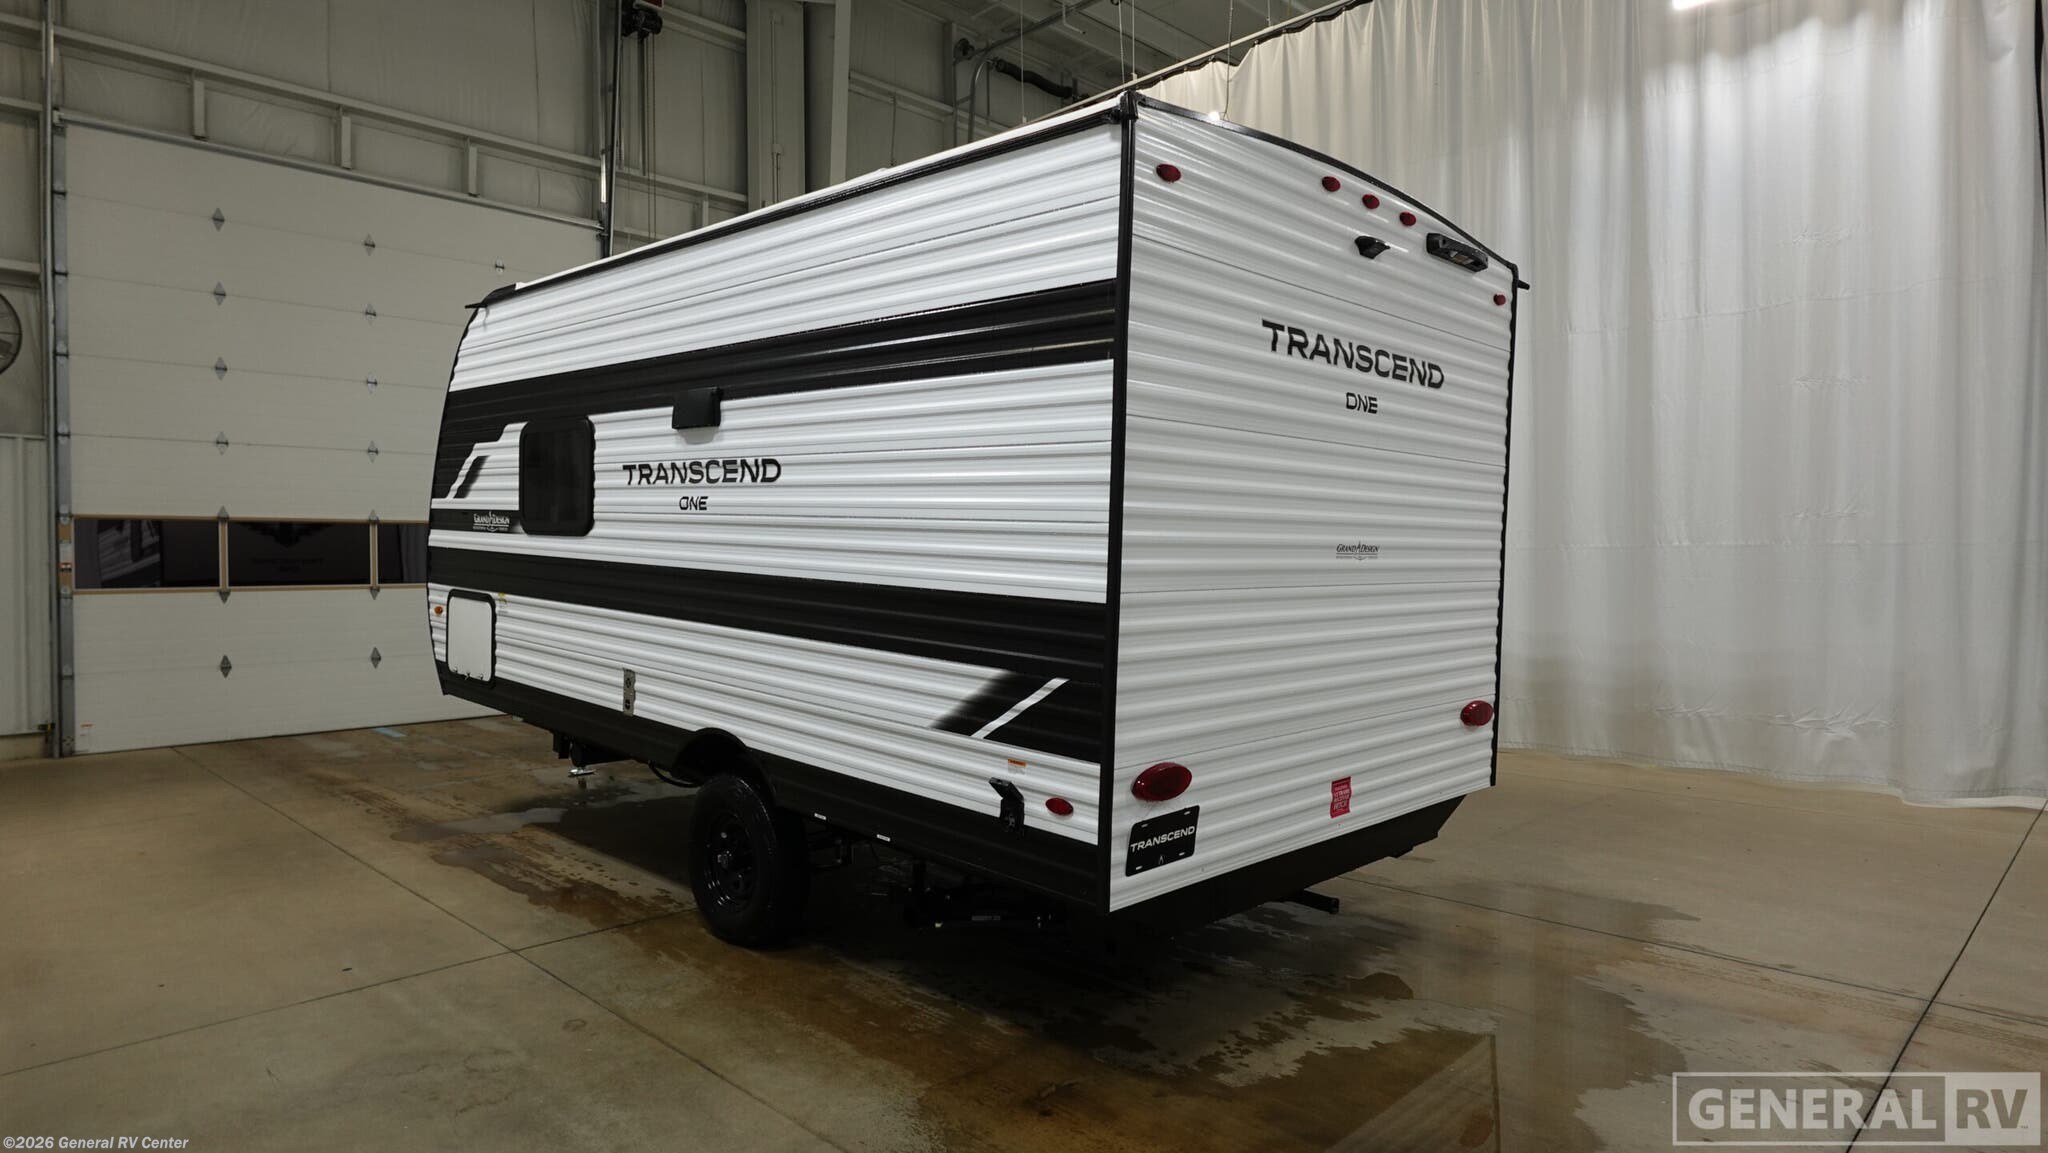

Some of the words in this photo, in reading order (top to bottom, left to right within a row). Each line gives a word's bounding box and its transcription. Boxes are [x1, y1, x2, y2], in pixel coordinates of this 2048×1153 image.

[1262, 319, 1445, 389] TRANSCEND
[622, 458, 782, 485] TRANSCEND
[679, 496, 709, 511] ONE
[1130, 825, 1196, 852] TRANSCEND
